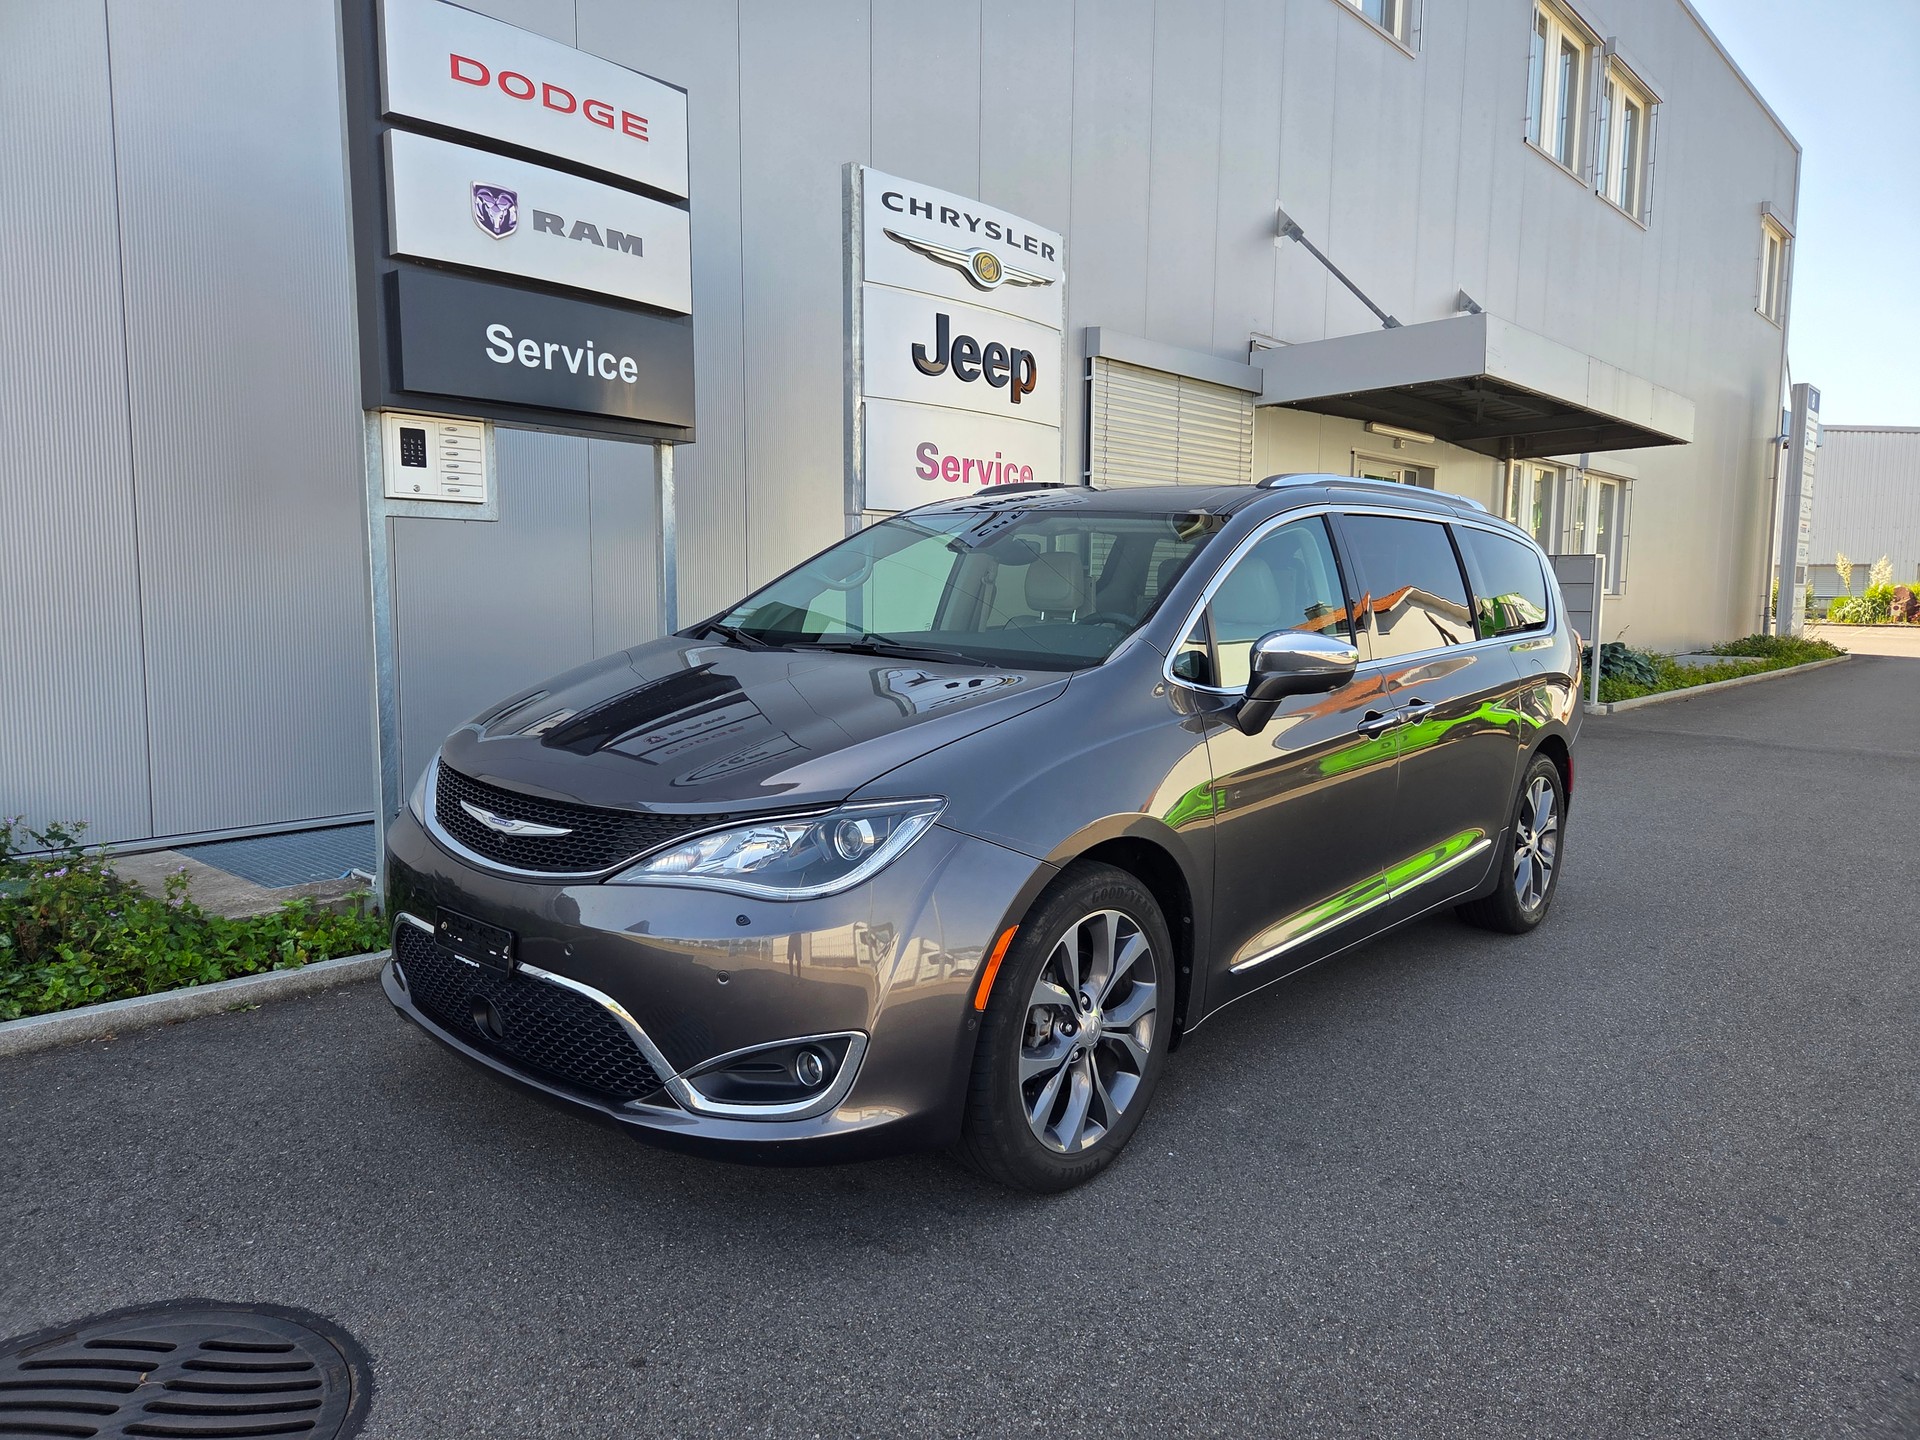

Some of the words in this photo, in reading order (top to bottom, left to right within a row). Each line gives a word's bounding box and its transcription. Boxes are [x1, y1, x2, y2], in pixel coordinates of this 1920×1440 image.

[450, 53, 648, 141] DODGE
[532, 209, 643, 257] RAM
[881, 191, 1055, 262] CHRYSLER
[485, 323, 639, 384] Service
[911, 313, 1037, 404] Jeep
[915, 442, 1034, 486] Service
